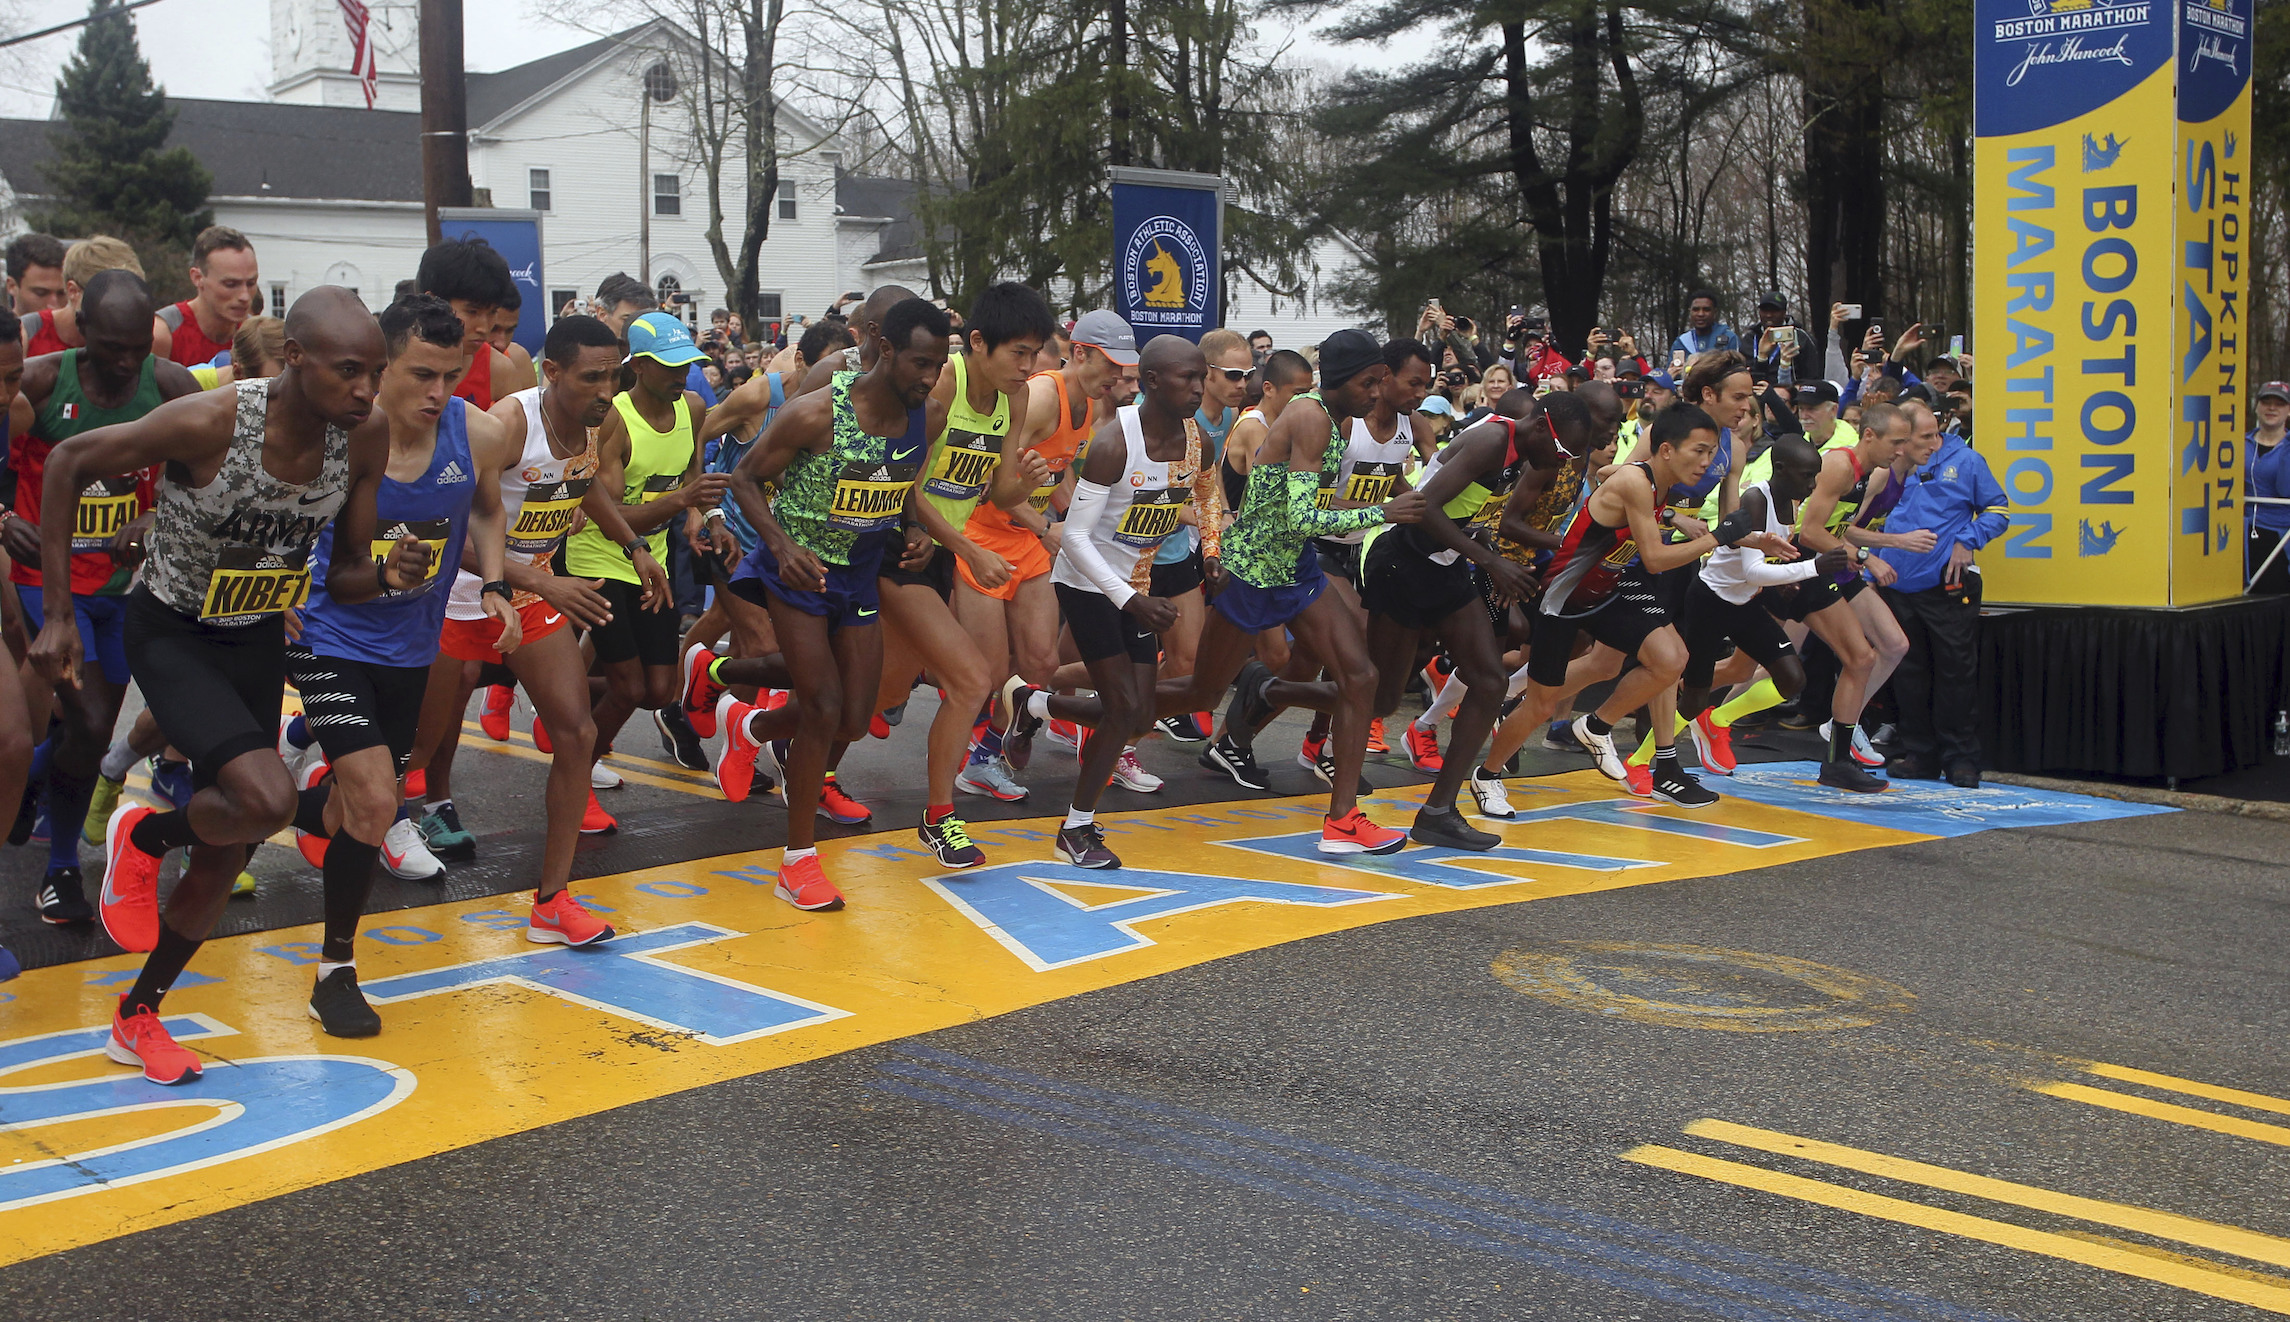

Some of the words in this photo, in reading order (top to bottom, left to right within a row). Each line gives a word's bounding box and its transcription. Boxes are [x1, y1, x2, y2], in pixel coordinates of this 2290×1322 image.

[1995, 17, 2055, 39] BOSTON
[2061, 6, 2149, 31] MARATHON
[2186, 5, 2212, 26] BOSTON
[2212, 12, 2246, 35] MARATHON
[2006, 41, 2056, 87] John
[2055, 33, 2133, 66] Hancock
[1126, 248, 1139, 300] BOSTON
[1134, 220, 1175, 248] ATHLETIC
[1174, 225, 1206, 307] ASSOCIATION
[1130, 310, 1158, 323] BOSTON
[1160, 311, 1203, 324] MARATHON
[2005, 145, 2055, 559] MARATHON
[2080, 184, 2138, 505] BOSTON
[2181, 139, 2217, 557] START
[2217, 169, 2239, 511] HOPKINTON
[967, 443, 987, 451] adidas
[436, 474, 468, 485] adidas
[834, 487, 907, 513] LEMMA
[80, 500, 136, 534] UTAI
[1123, 506, 1178, 535] KIRUI
[208, 569, 310, 616] KIBET
[234, 614, 262, 622] BOSTON
